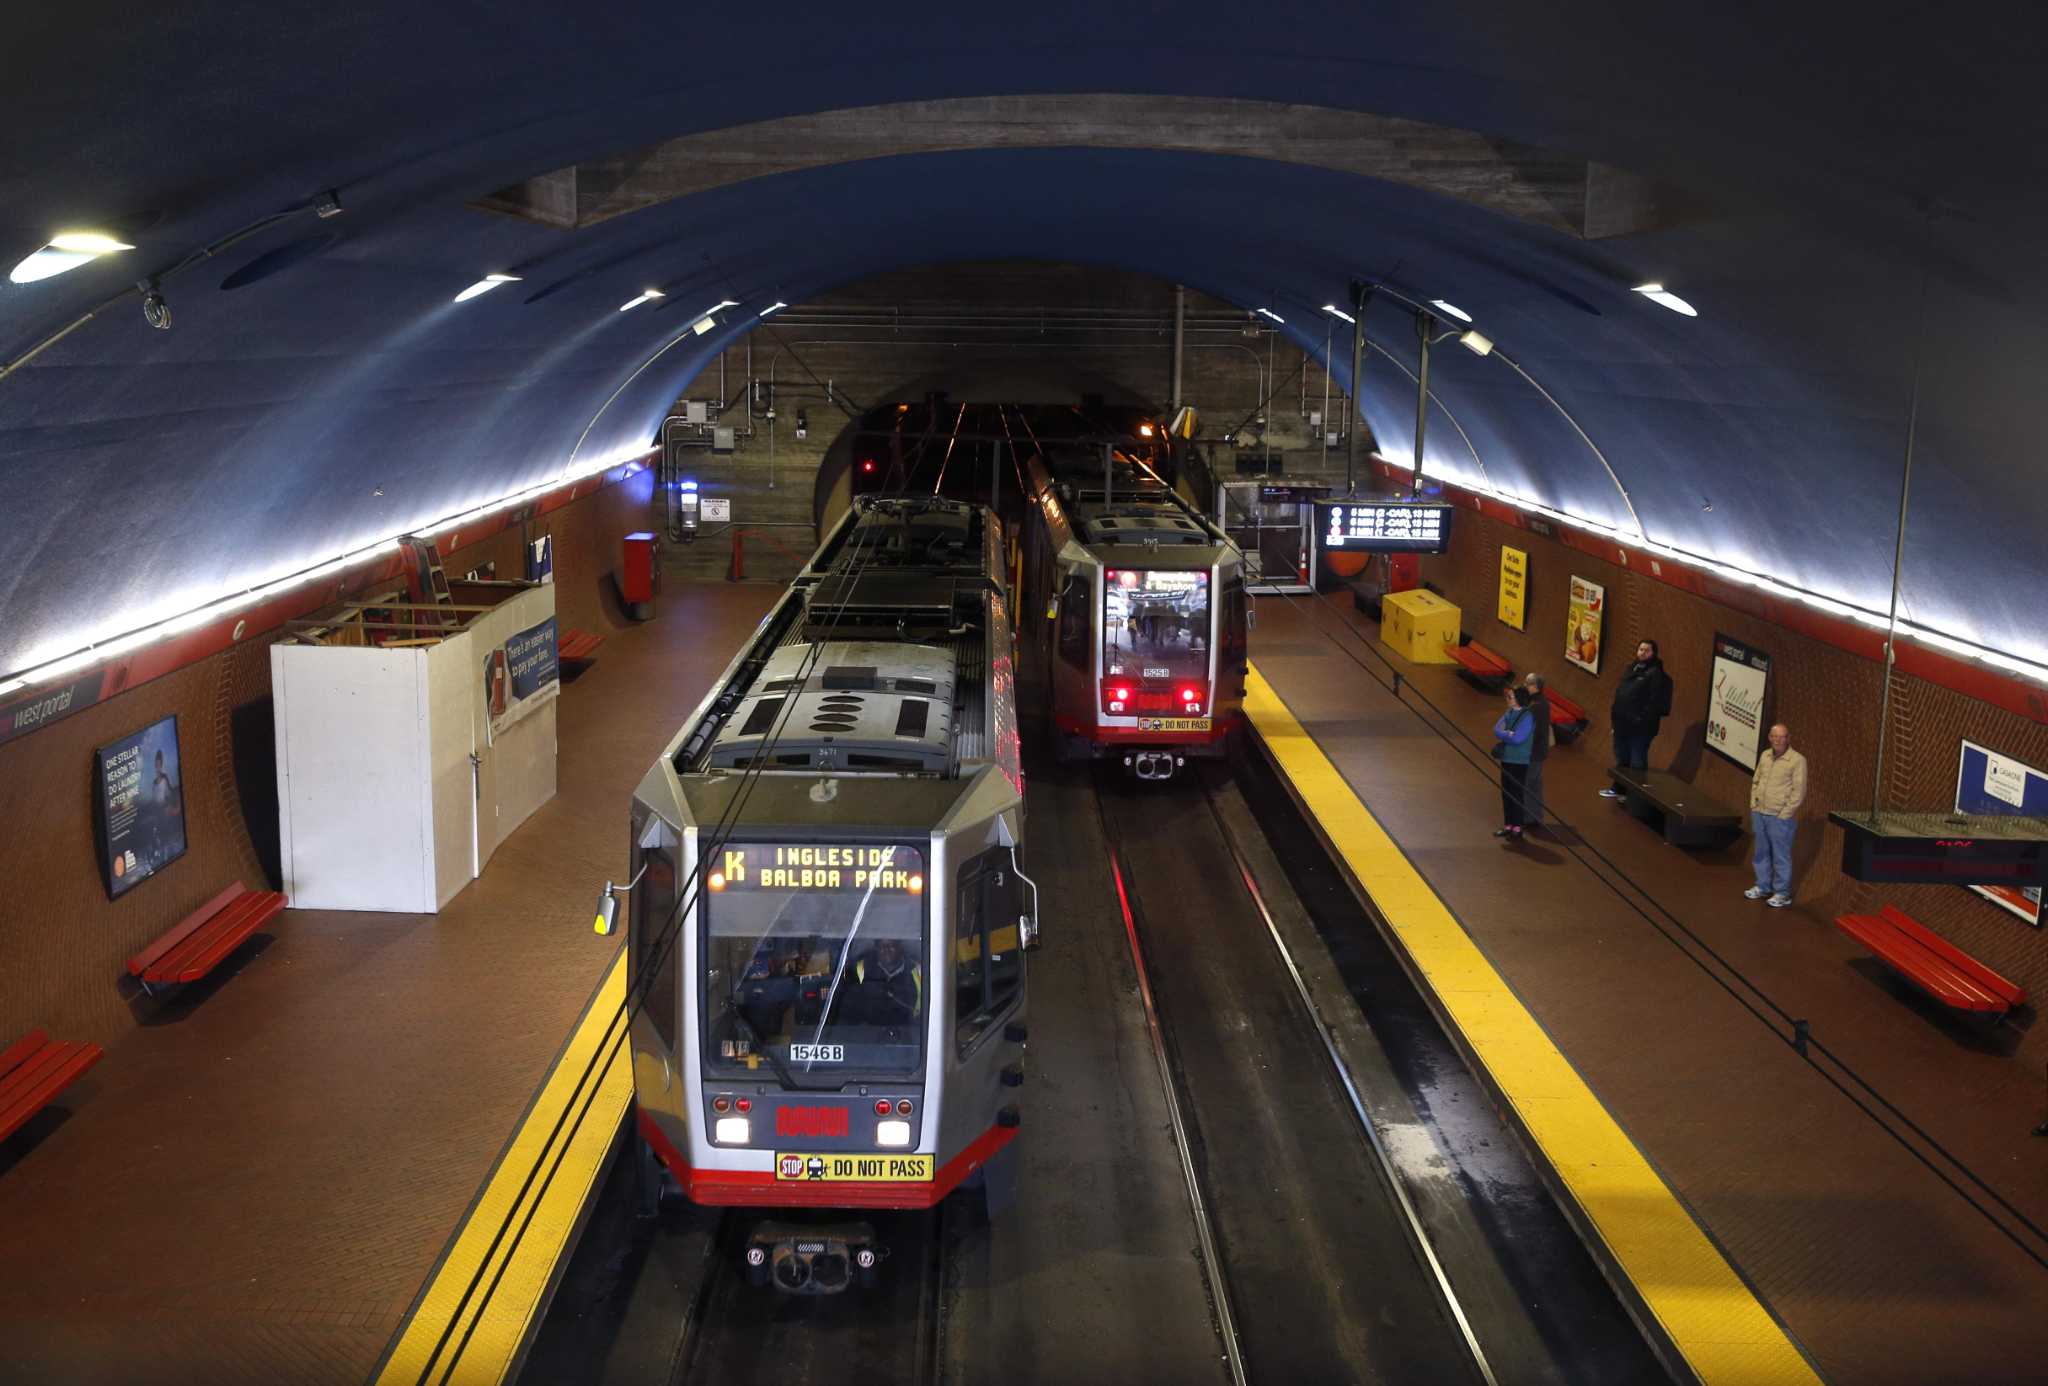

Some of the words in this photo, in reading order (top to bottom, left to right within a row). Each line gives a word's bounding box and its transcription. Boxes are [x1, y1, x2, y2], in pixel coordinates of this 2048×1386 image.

[14, 702, 42, 729] west
[40, 685, 75, 723] portal
[1165, 720, 1175, 729] DO
[1177, 720, 1190, 729] NOT
[1192, 720, 1208, 729] PASS
[106, 756, 118, 769] ONE
[118, 745, 139, 764] STELLAR
[107, 765, 128, 782] REASON
[128, 760, 137, 771] TO
[724, 851, 745, 881] K
[777, 847, 894, 867] INGLESIDE
[760, 869, 840, 888] BALBOA
[855, 870, 909, 889] PARK
[792, 1045, 830, 1060] 1546
[832, 1046, 842, 1060] B
[781, 1159, 803, 1175] STOP
[834, 1159, 851, 1176] DO
[857, 1160, 886, 1176] NOT
[890, 1160, 925, 1177] PASS
